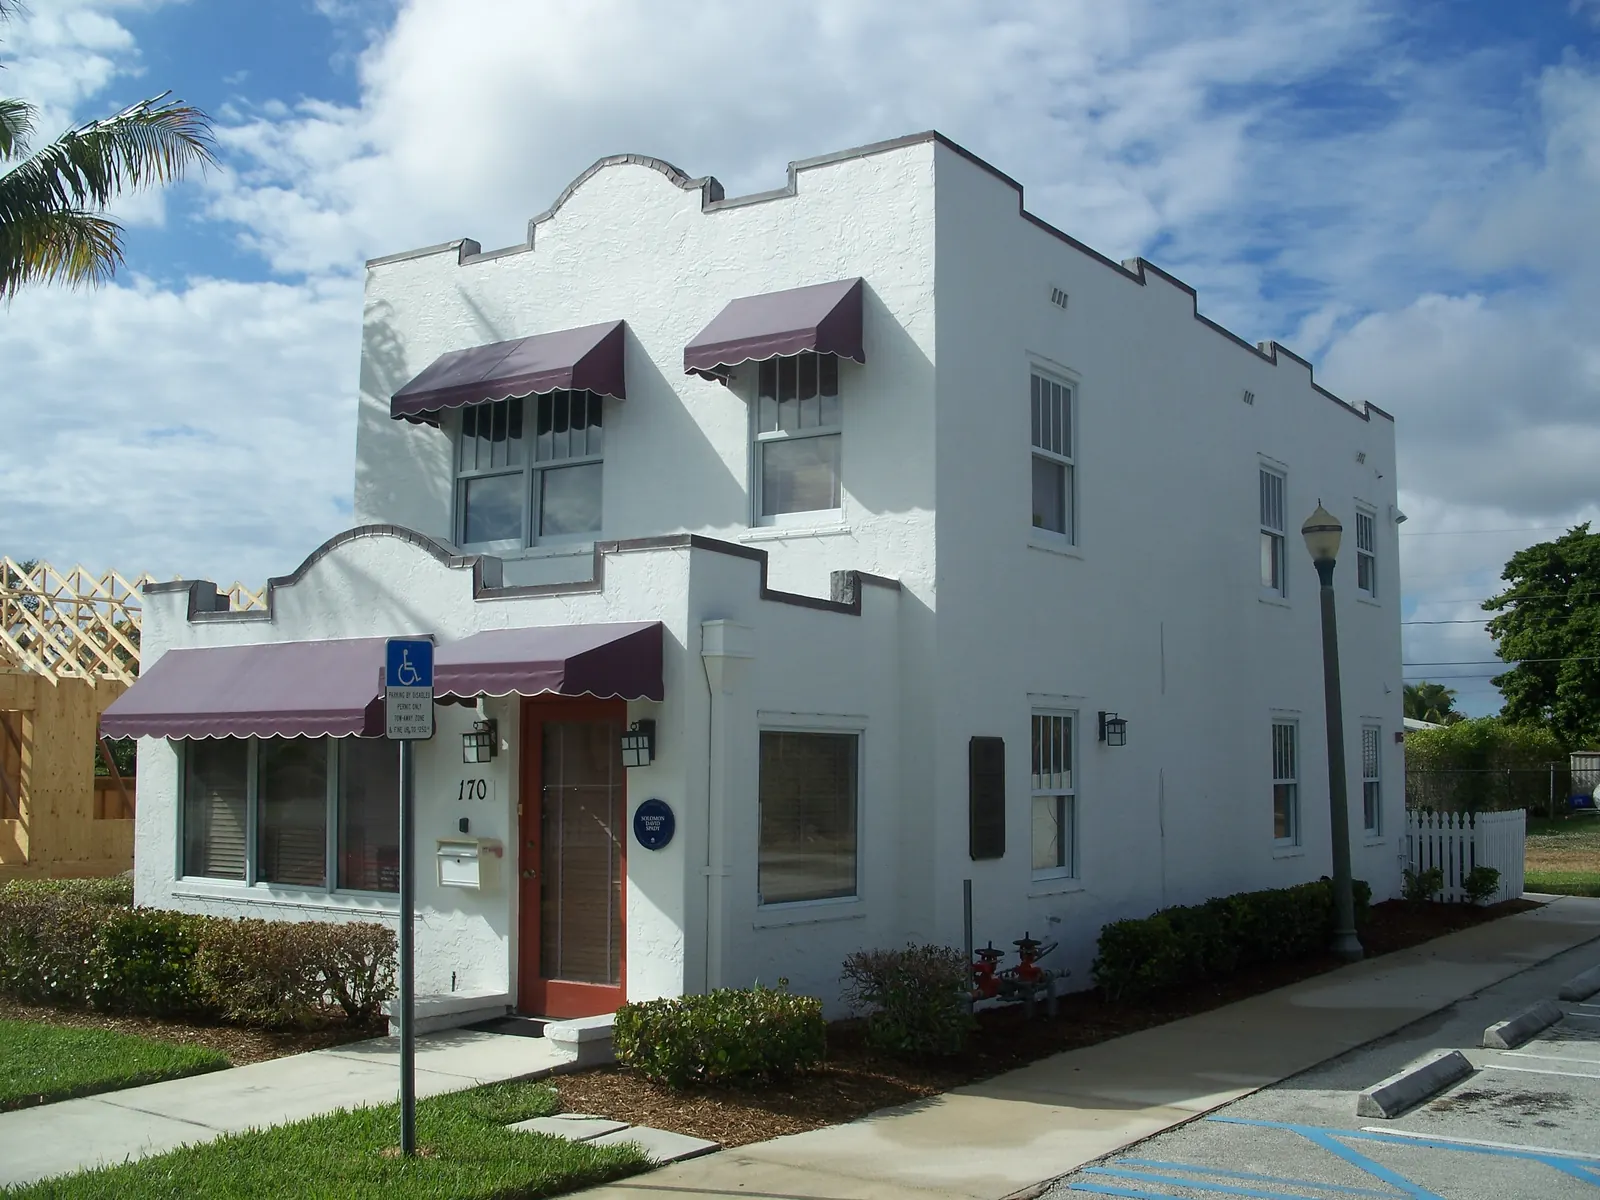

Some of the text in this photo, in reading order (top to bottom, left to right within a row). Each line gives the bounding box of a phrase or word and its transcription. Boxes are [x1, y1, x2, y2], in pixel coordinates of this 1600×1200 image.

[389, 691, 430, 699] PARKING BY DISABLED
[397, 703, 422, 711] PERMIT ONLY
[394, 714, 425, 722] TOW-AWAY ZONE
[394, 726, 403, 734] FINE
[411, 726, 417, 734] TO
[458, 778, 487, 801] 170
